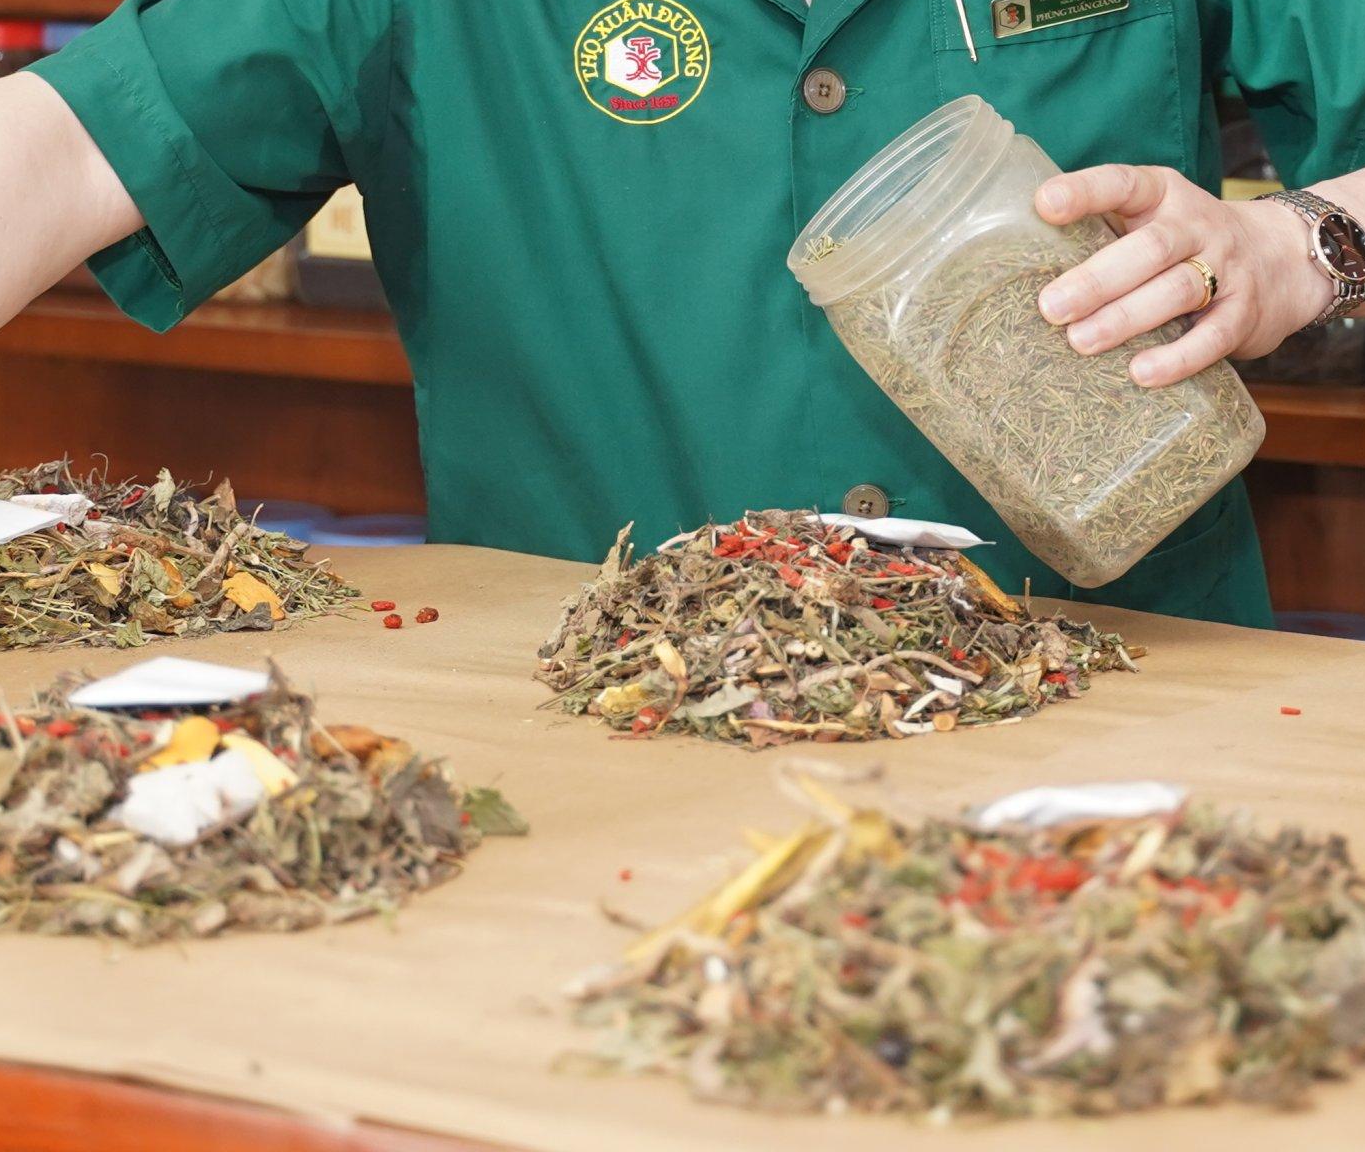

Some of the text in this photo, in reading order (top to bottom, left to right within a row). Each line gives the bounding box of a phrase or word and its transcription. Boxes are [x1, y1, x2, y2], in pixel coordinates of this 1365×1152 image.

[1037, 9, 1067, 22] PHÙNG
[1069, 1, 1092, 14] TUẤN
[580, 1, 704, 83] THỌ XUÂN ĐƯỜNG
[609, 96, 648, 111] Since
